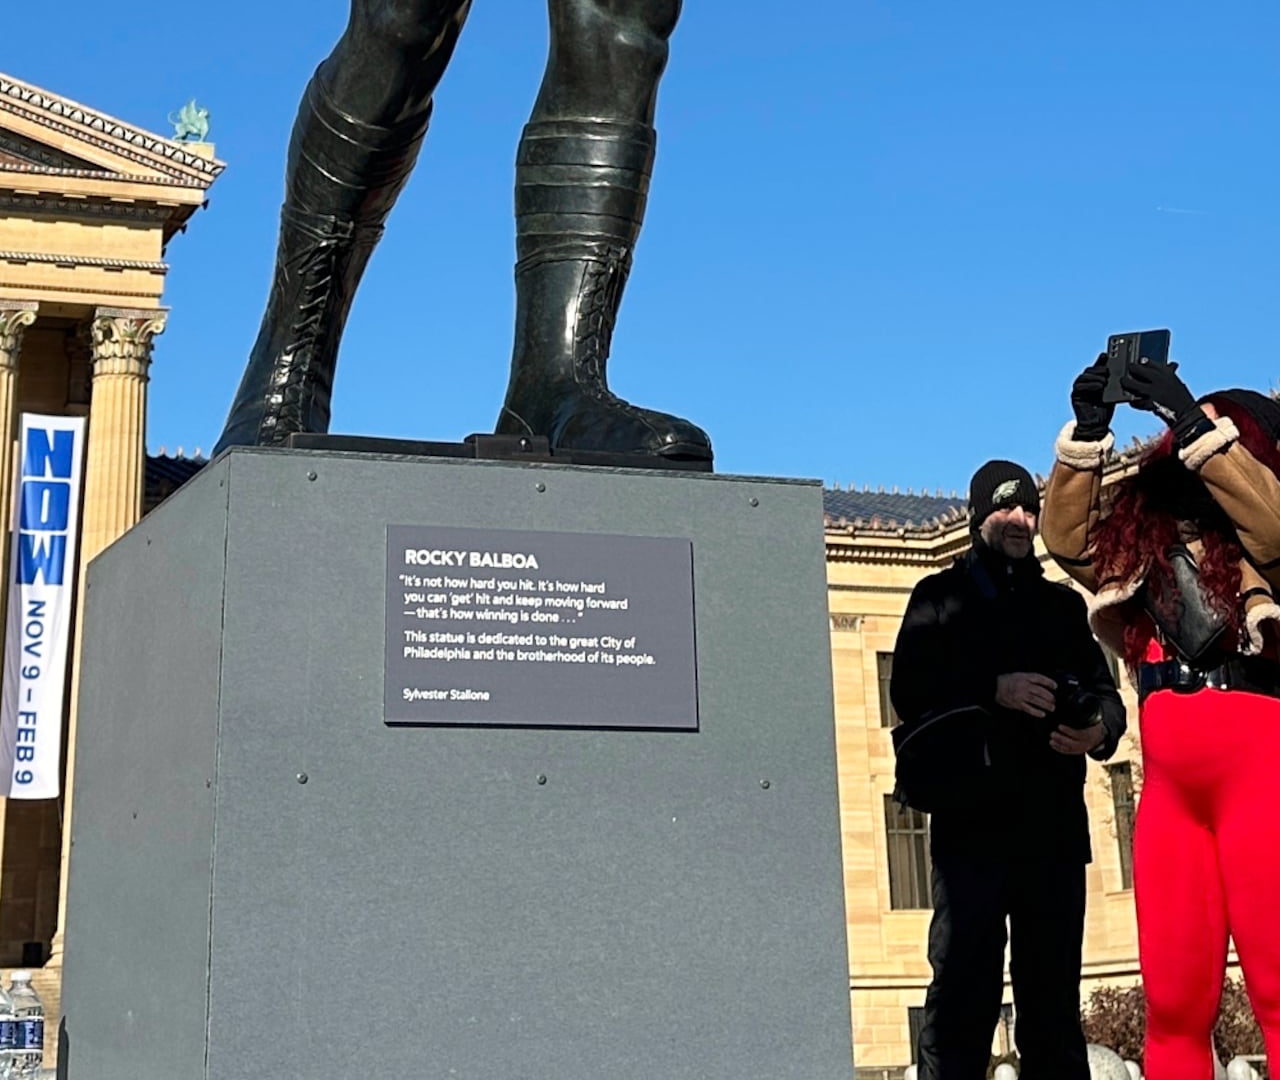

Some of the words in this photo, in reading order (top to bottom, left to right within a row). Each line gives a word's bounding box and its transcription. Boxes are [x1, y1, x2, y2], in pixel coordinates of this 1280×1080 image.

[16, 427, 75, 586] NOW
[405, 549, 467, 567] ROCKY
[469, 551, 539, 569] BALBOA
[423, 576, 443, 588] not
[444, 576, 468, 589] how
[470, 577, 496, 590] hard
[497, 580, 518, 592] you
[556, 580, 580, 593] how
[580, 581, 605, 594] hard
[404, 592, 425, 604] you
[426, 593, 448, 603] can
[475, 593, 491, 605] hit
[492, 594, 514, 606] and
[515, 594, 543, 608] keep
[544, 596, 585, 610] moving
[585, 596, 629, 610] forward
[449, 607, 474, 620] how
[475, 608, 519, 624] winning
[520, 610, 530, 622] is
[531, 610, 560, 623] done
[22, 599, 47, 659] NOV
[404, 630, 428, 643] This
[428, 631, 465, 644] statue
[466, 631, 476, 644] is
[477, 632, 534, 646] dedicated
[534, 635, 548, 646] to
[548, 634, 569, 647] the
[569, 636, 599, 650] great
[600, 636, 623, 651] City
[623, 636, 637, 649] of
[403, 646, 472, 661] Philadelphia
[472, 648, 495, 660] and
[495, 648, 516, 661] the
[516, 648, 586, 663] brotherhood
[587, 651, 600, 663] of
[600, 651, 616, 665] its
[616, 652, 656, 667] people.
[21, 665, 41, 680] 9
[403, 687, 449, 702] Sylvester
[449, 689, 490, 701] Stallone
[15, 710, 37, 762] FEB
[14, 769, 34, 785] 9
